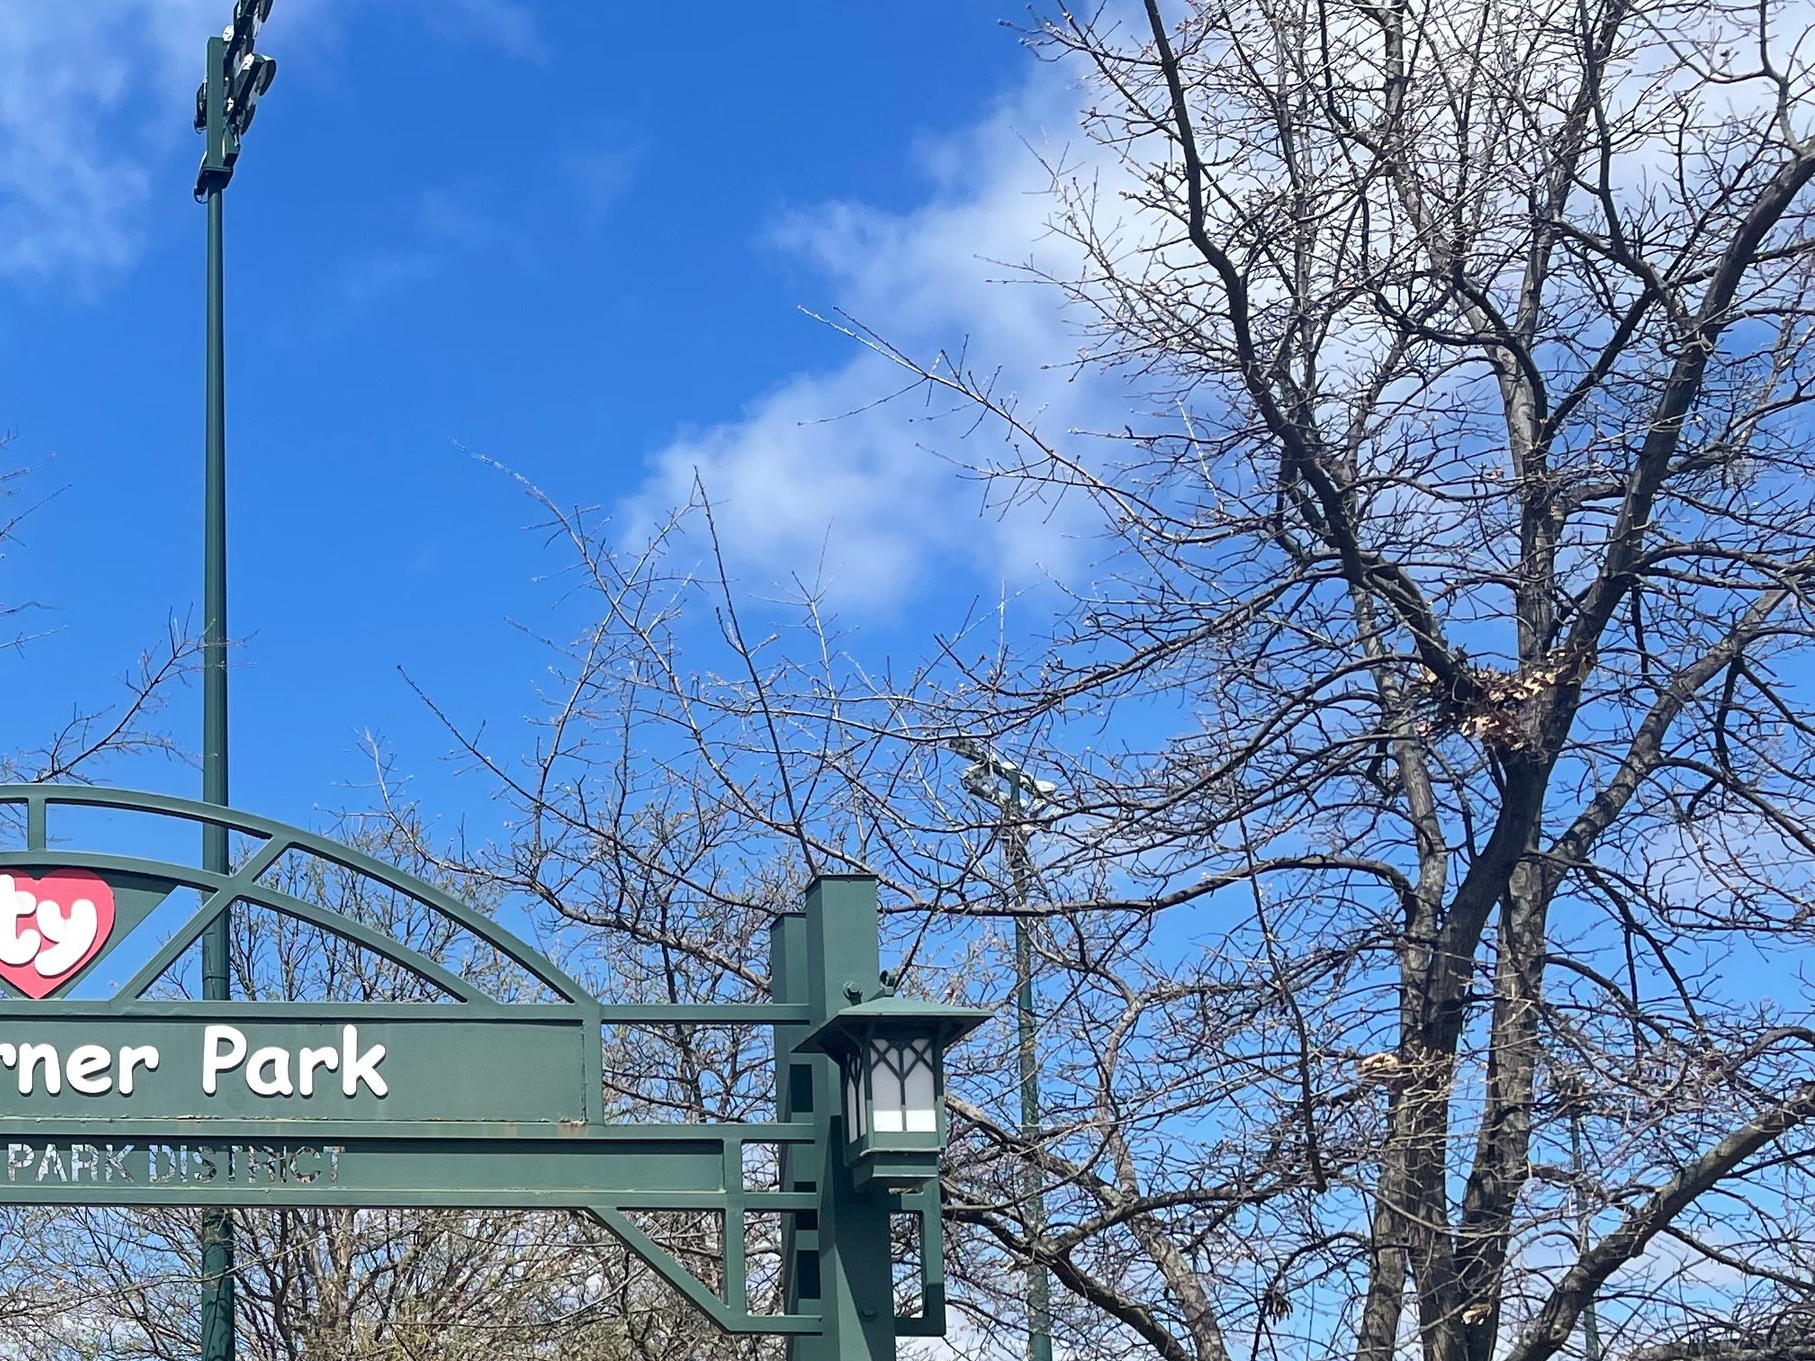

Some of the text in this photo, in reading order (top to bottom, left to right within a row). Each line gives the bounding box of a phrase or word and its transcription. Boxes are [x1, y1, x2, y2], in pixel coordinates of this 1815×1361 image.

[202, 1024, 389, 1097] Park
[6, 1142, 135, 1183] PARK
[148, 1143, 346, 1185] DISTRICT
